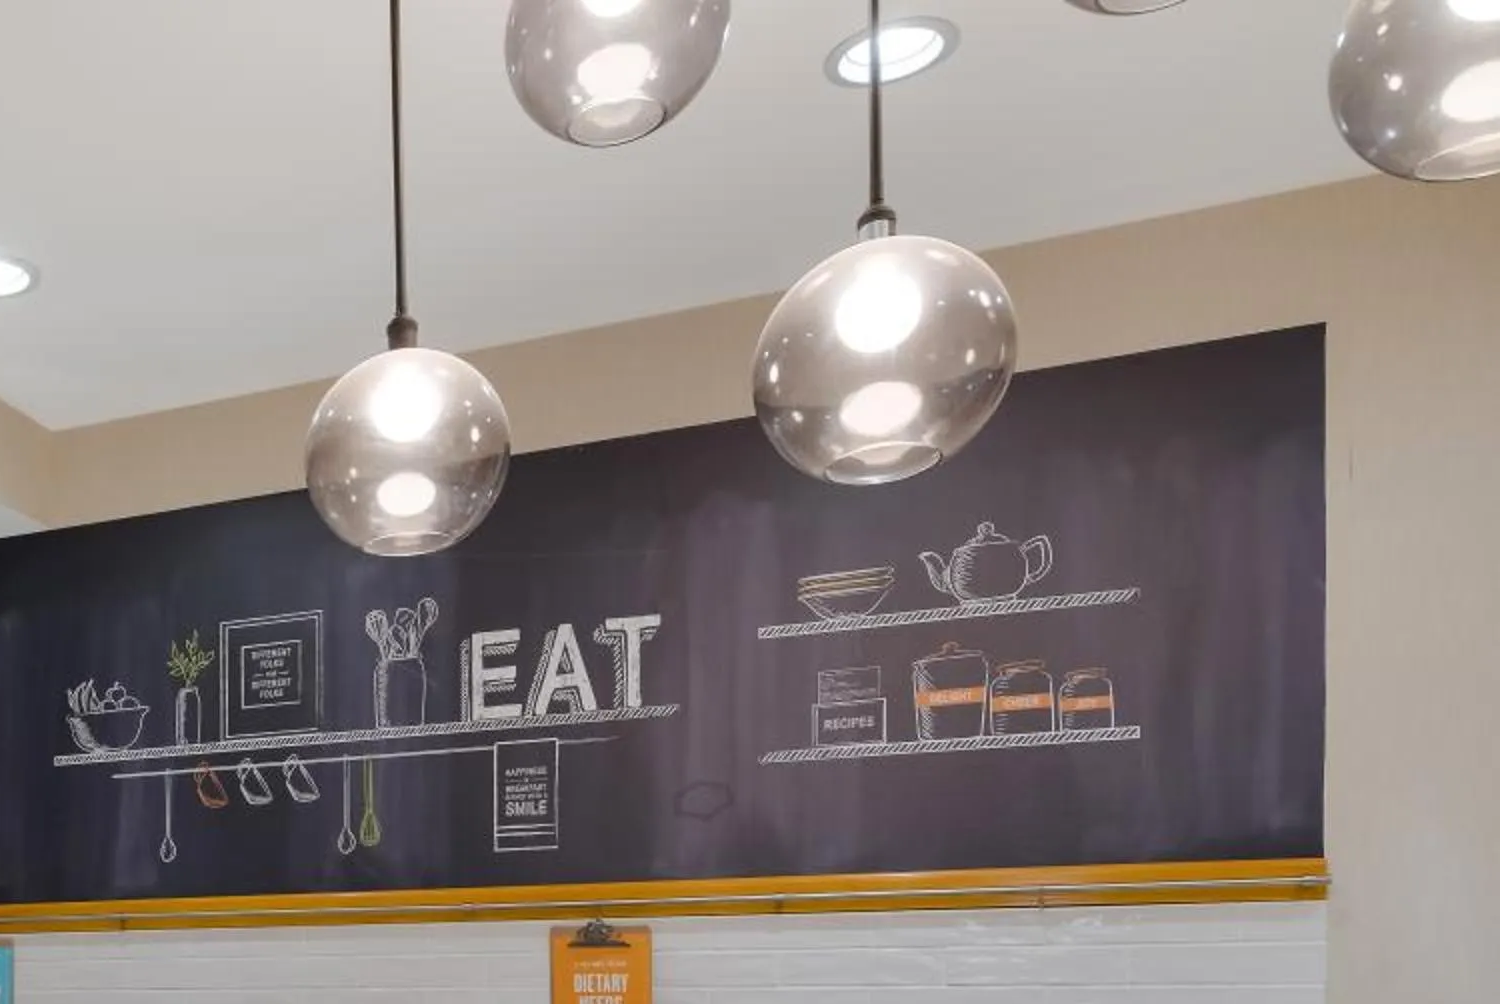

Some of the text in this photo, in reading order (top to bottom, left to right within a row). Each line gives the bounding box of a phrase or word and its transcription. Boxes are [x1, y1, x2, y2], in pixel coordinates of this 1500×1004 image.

[460, 614, 662, 721] EAT
[504, 799, 548, 817] SMILE
[574, 973, 629, 993] DIETARY
